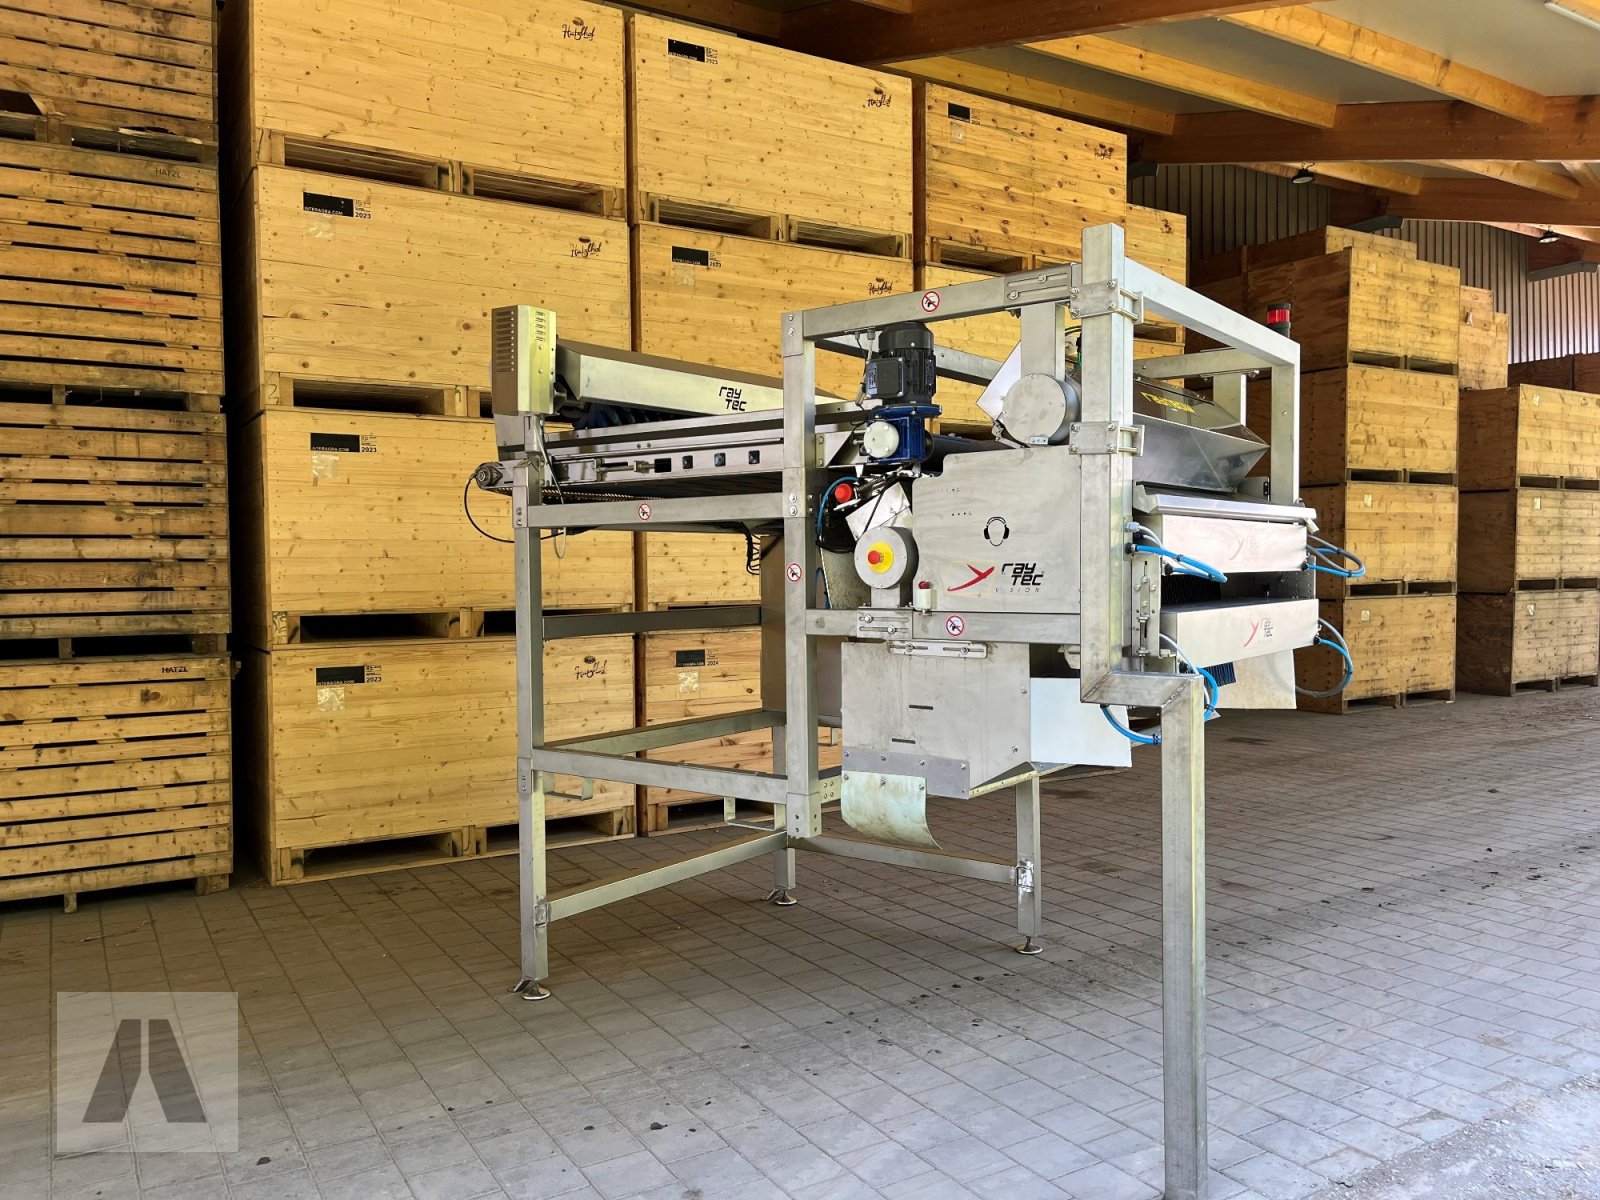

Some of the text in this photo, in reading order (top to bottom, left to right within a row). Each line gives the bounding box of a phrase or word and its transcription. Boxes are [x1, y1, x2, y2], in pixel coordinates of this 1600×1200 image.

[155, 167, 183, 179] HATZL
[355, 211, 371, 219] 2023
[719, 386, 742, 400] ray
[1001, 563, 1036, 575] ray
